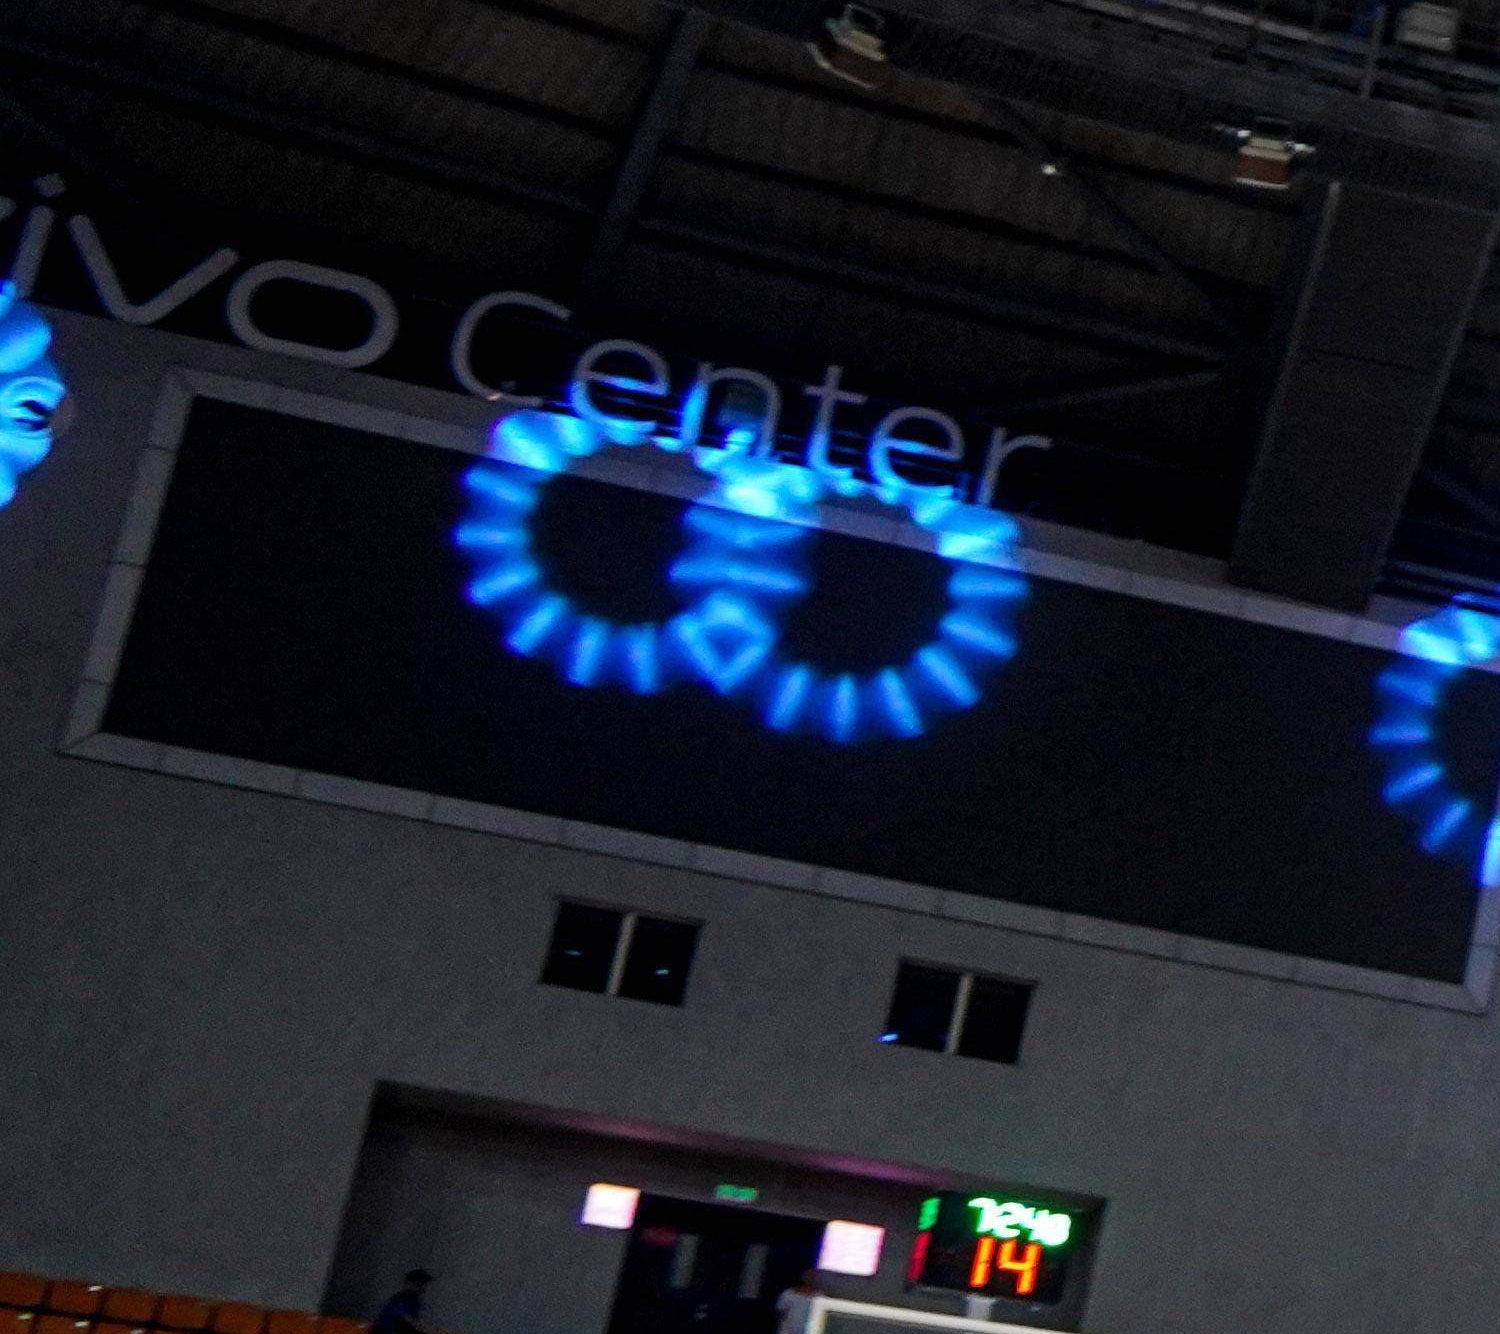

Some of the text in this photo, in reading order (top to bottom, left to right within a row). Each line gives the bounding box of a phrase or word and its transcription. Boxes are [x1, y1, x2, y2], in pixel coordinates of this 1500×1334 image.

[0, 172, 1053, 508] ivo Center
[969, 1234, 1043, 1296] 14
